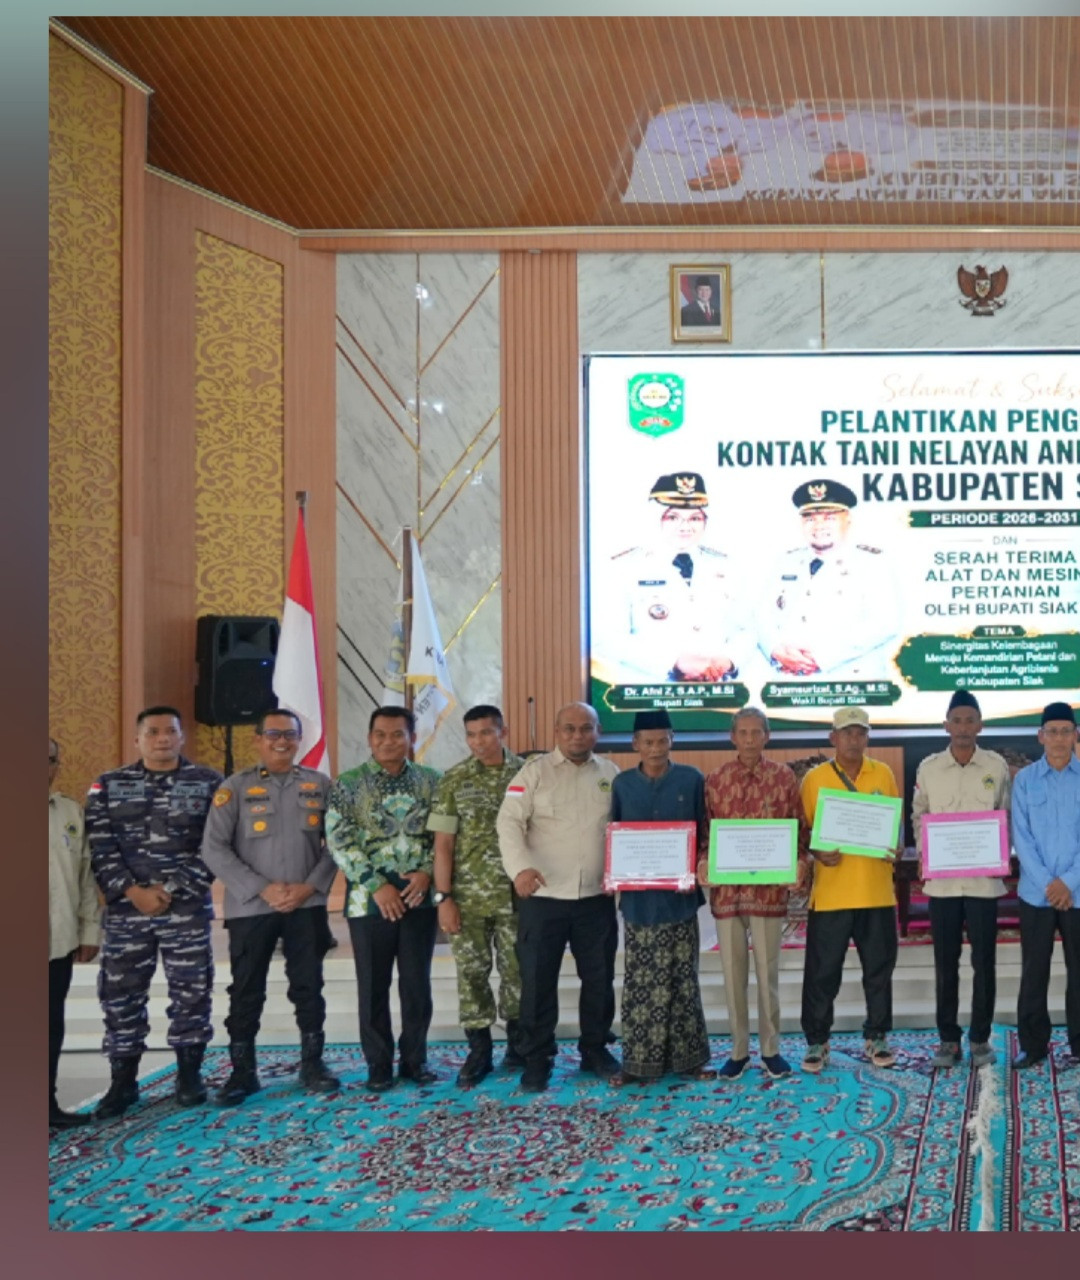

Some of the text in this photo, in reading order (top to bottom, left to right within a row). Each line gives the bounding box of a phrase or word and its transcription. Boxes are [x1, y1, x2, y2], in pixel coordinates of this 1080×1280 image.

[880, 373, 979, 402] Selamat
[820, 409, 996, 433] PELANTIKAN
[717, 441, 826, 467] KONTAK
[836, 441, 899, 466] TANI
[909, 440, 1028, 465] NELAYAN
[862, 471, 1063, 502] KABUPATEN
[931, 512, 998, 525] PERIODE
[992, 535, 1018, 545] DAN
[934, 551, 1077, 565] SERAH TERIMA
[925, 568, 974, 581] ALAT
[980, 568, 1020, 581] DAN
[951, 586, 1060, 598] PERTANIAN
[925, 602, 1078, 616] OLEH BUPATI SIAK
[984, 627, 1014, 635] TEMA
[940, 641, 989, 652] Sinergitas
[925, 653, 961, 664] Menuju
[1026, 652, 1056, 661] Petani
[1058, 652, 1076, 661] dan
[956, 677, 1044, 688] di Kabupaten Siak
[624, 686, 640, 696] Dr.
